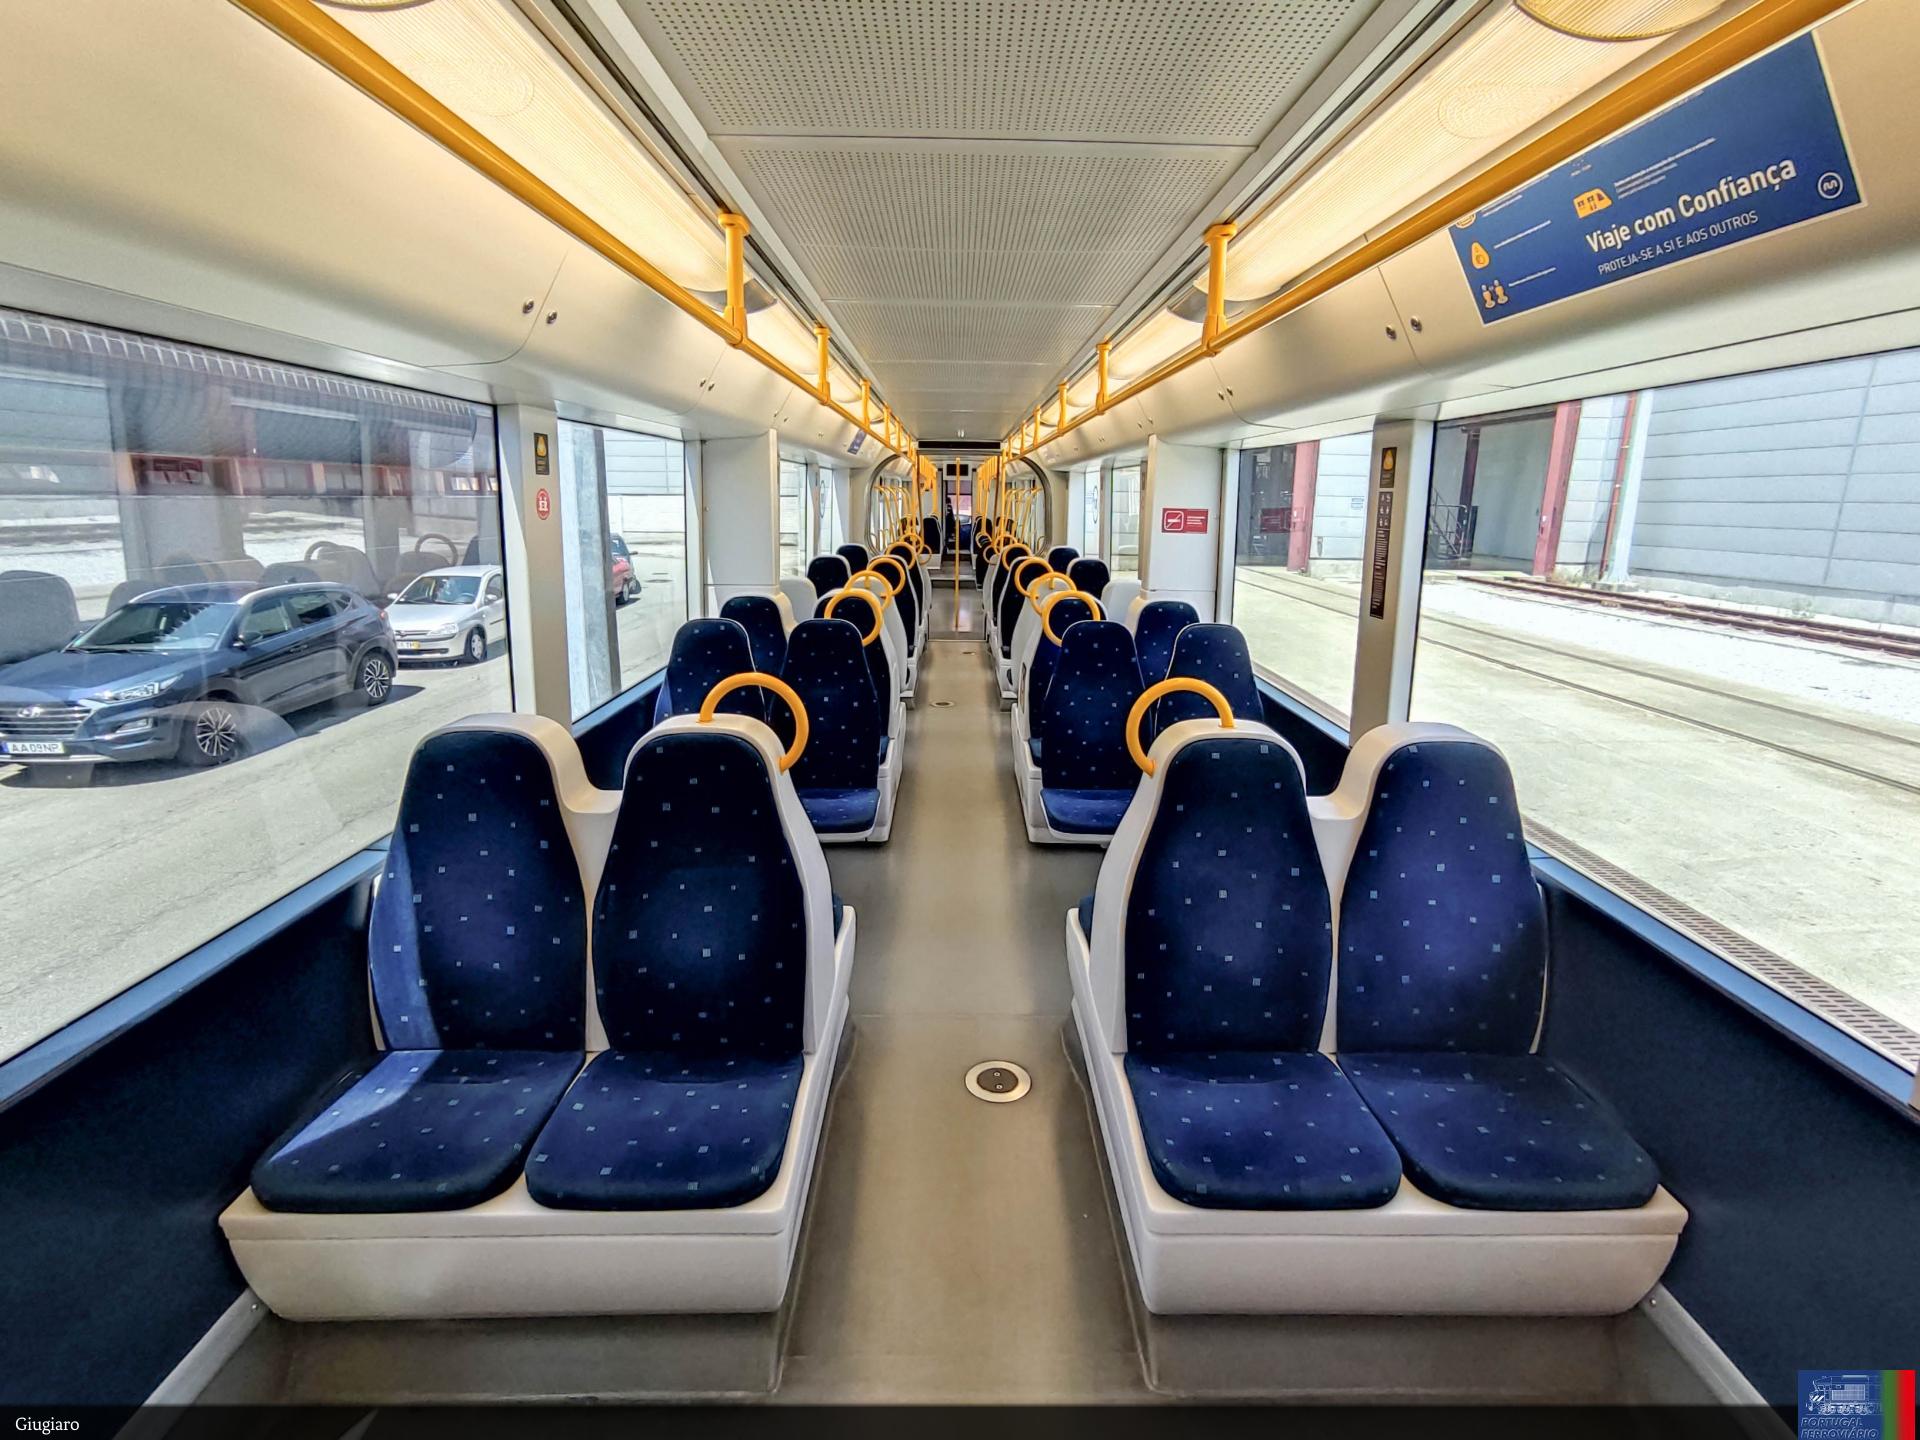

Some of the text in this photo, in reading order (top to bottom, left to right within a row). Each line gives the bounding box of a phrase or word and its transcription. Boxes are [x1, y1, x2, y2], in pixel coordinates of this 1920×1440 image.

[1585, 223, 1632, 253] Viaje
[1633, 207, 1677, 235] com
[1678, 158, 1797, 218] Confiança
[1597, 210, 1759, 275] PROTEJA-SE A SI E AOS OUTROS
